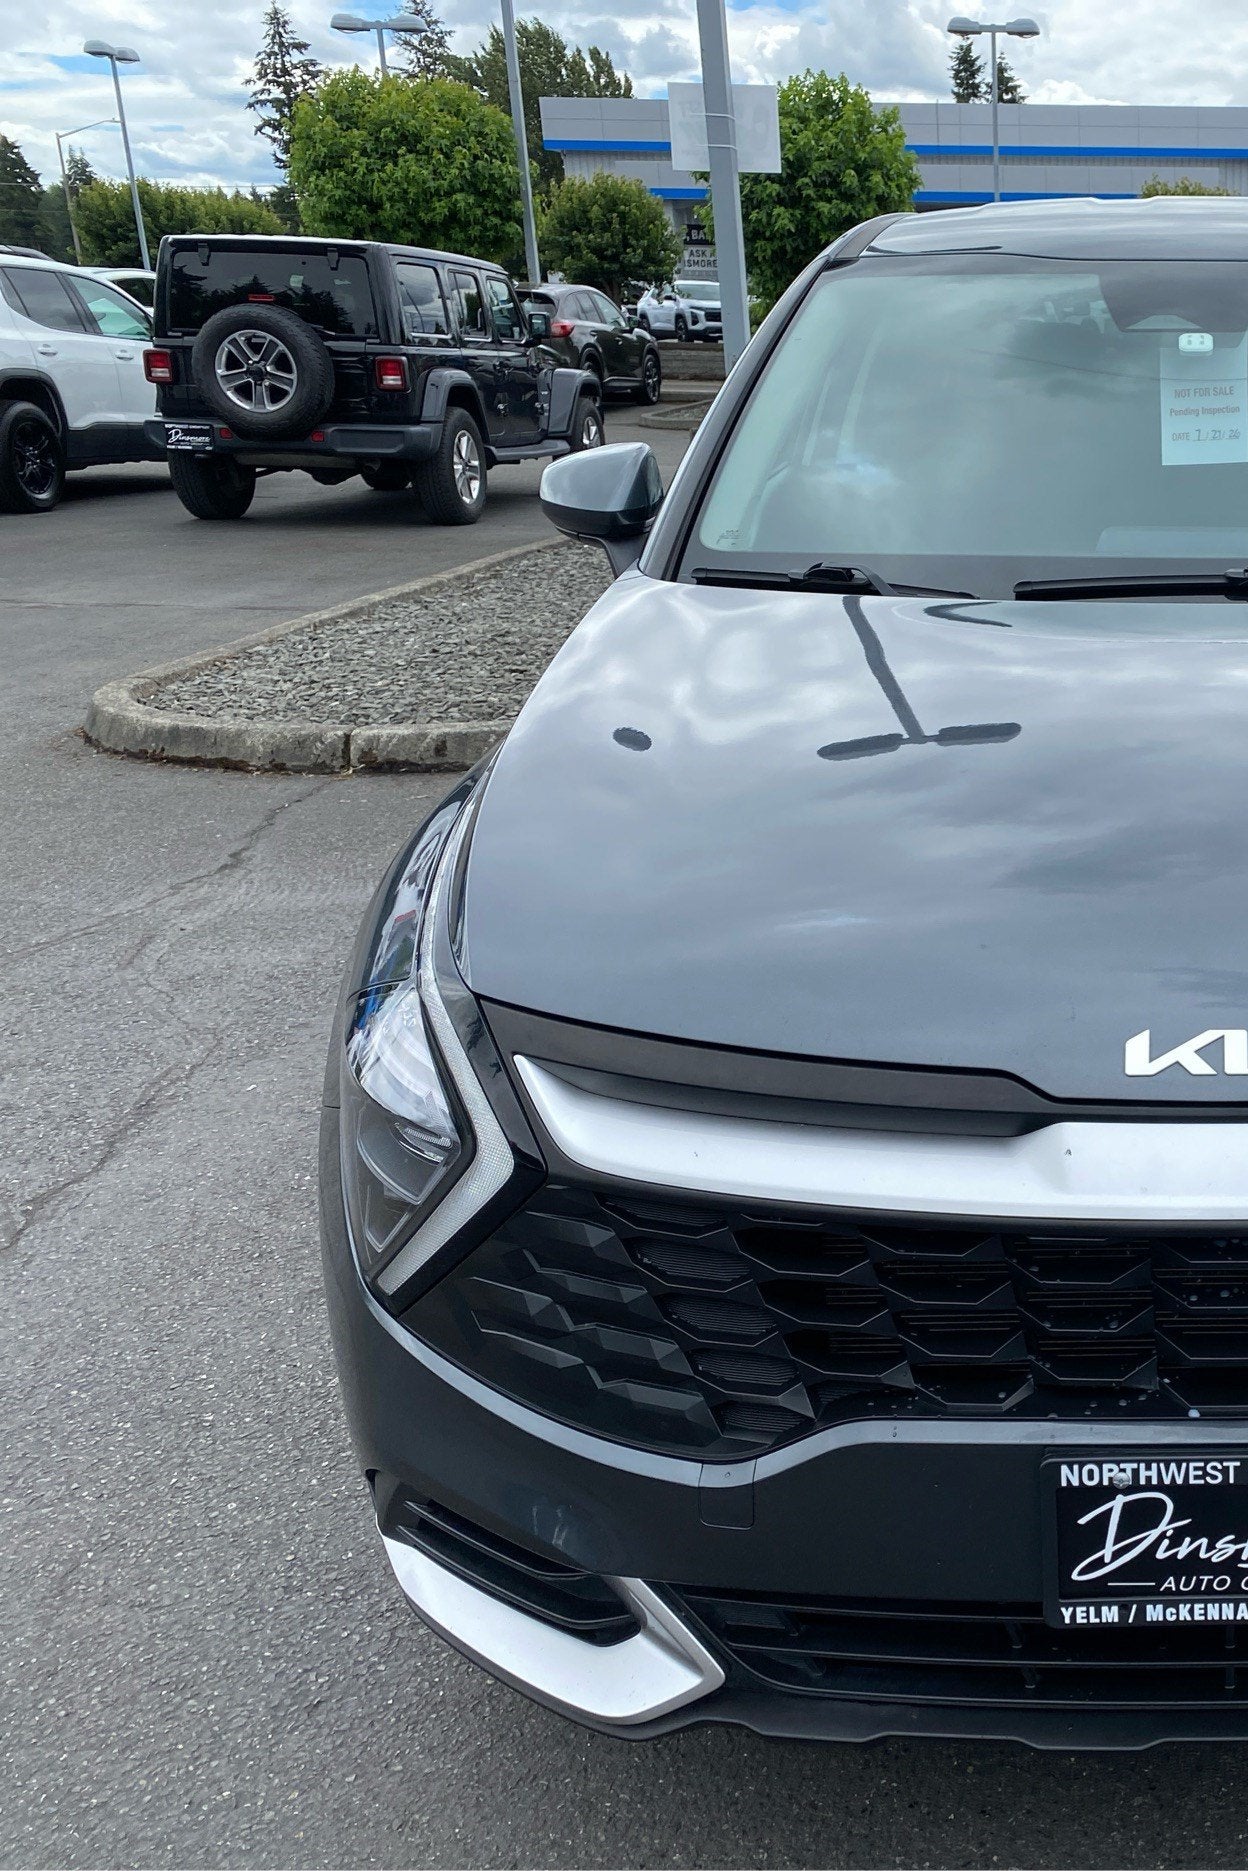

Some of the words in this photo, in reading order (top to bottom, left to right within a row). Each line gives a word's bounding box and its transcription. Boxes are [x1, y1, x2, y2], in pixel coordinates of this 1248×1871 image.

[689, 249, 707, 258] ASK
[1174, 388, 1191, 399] NOT
[1194, 388, 1211, 398] FOR
[1213, 386, 1235, 397] SALE
[1170, 407, 1200, 417] Pending
[1201, 405, 1240, 416] Inspection
[1172, 432, 1190, 442] DATE
[1159, 1575, 1231, 1592] AUTO
[1061, 1606, 1119, 1624] YELM
